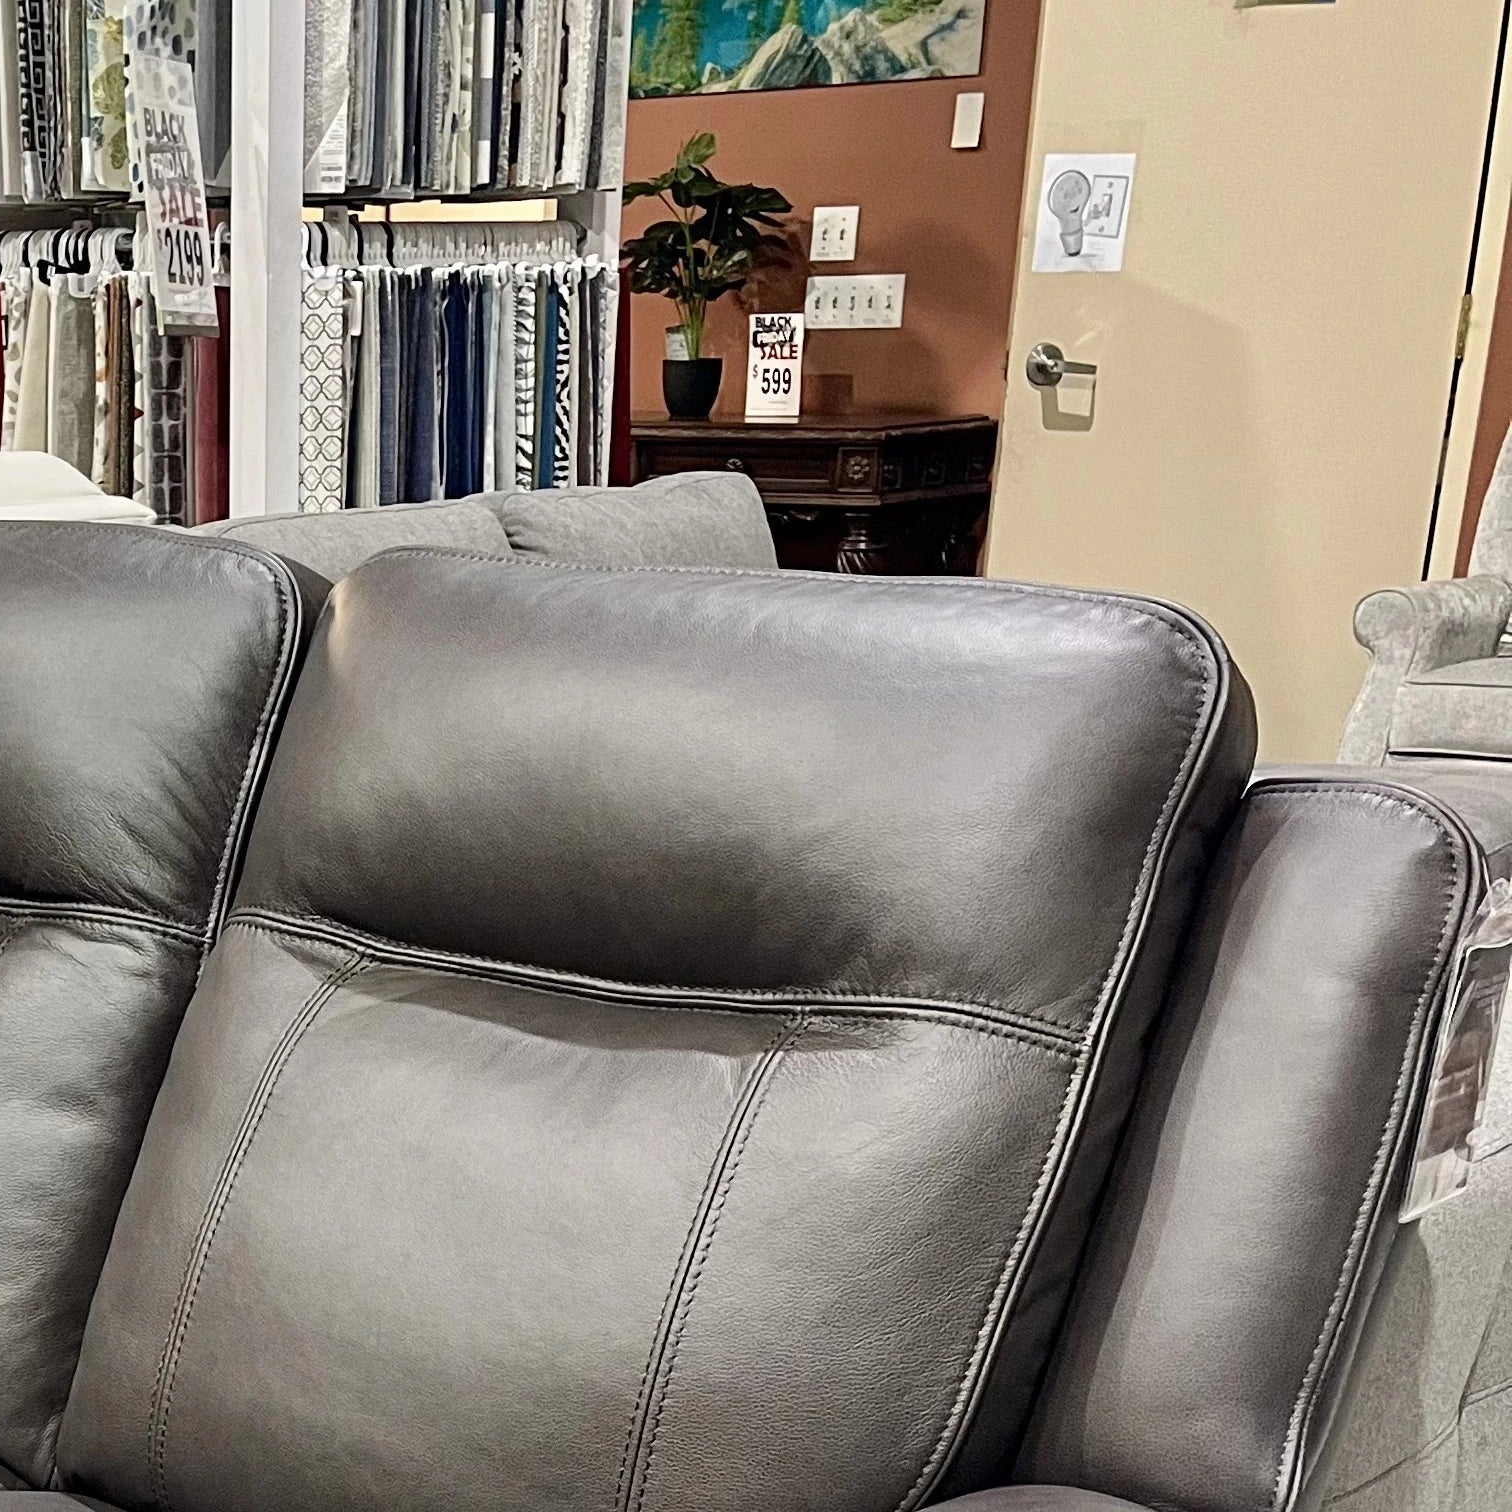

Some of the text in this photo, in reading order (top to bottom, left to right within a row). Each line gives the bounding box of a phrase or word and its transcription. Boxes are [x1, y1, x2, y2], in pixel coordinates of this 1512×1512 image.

[143, 107, 187, 144] BLACK
[157, 180, 204, 228] SALE
[755, 316, 792, 329] BLACK
[760, 343, 798, 360] SALE
